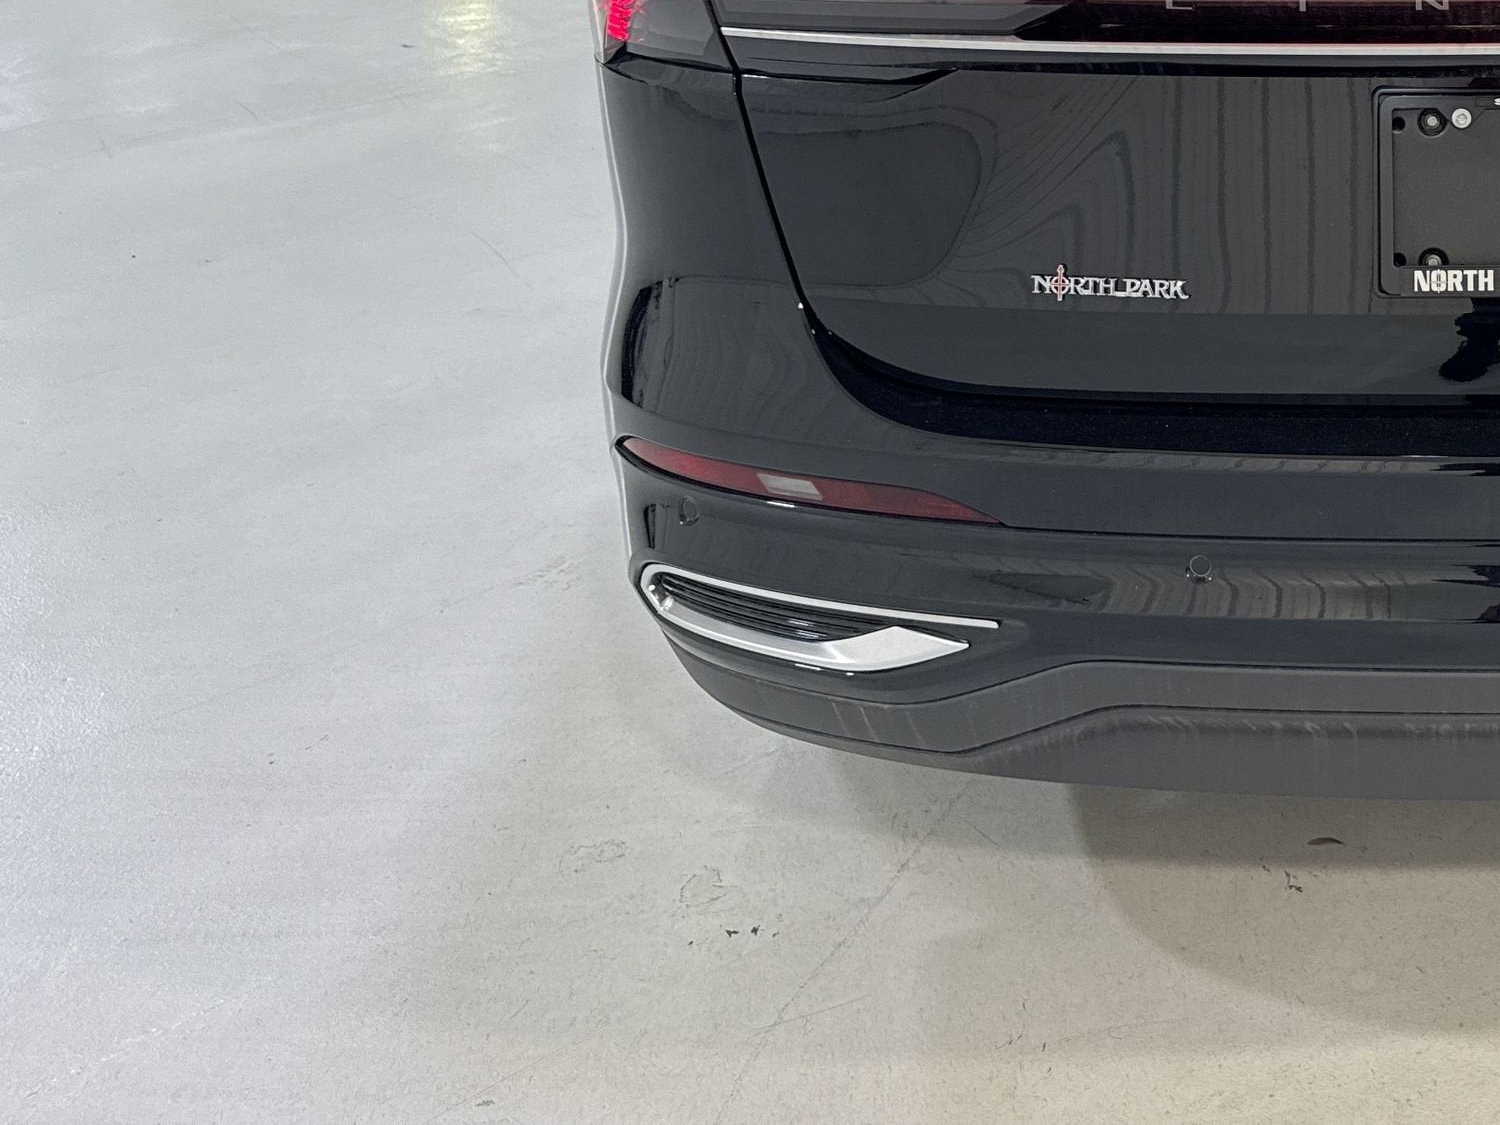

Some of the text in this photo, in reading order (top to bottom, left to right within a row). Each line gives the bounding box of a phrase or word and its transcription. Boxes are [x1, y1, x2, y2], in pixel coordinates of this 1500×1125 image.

[1031, 273, 1189, 299] NORTH PARK
[1414, 269, 1494, 292] NORTH
